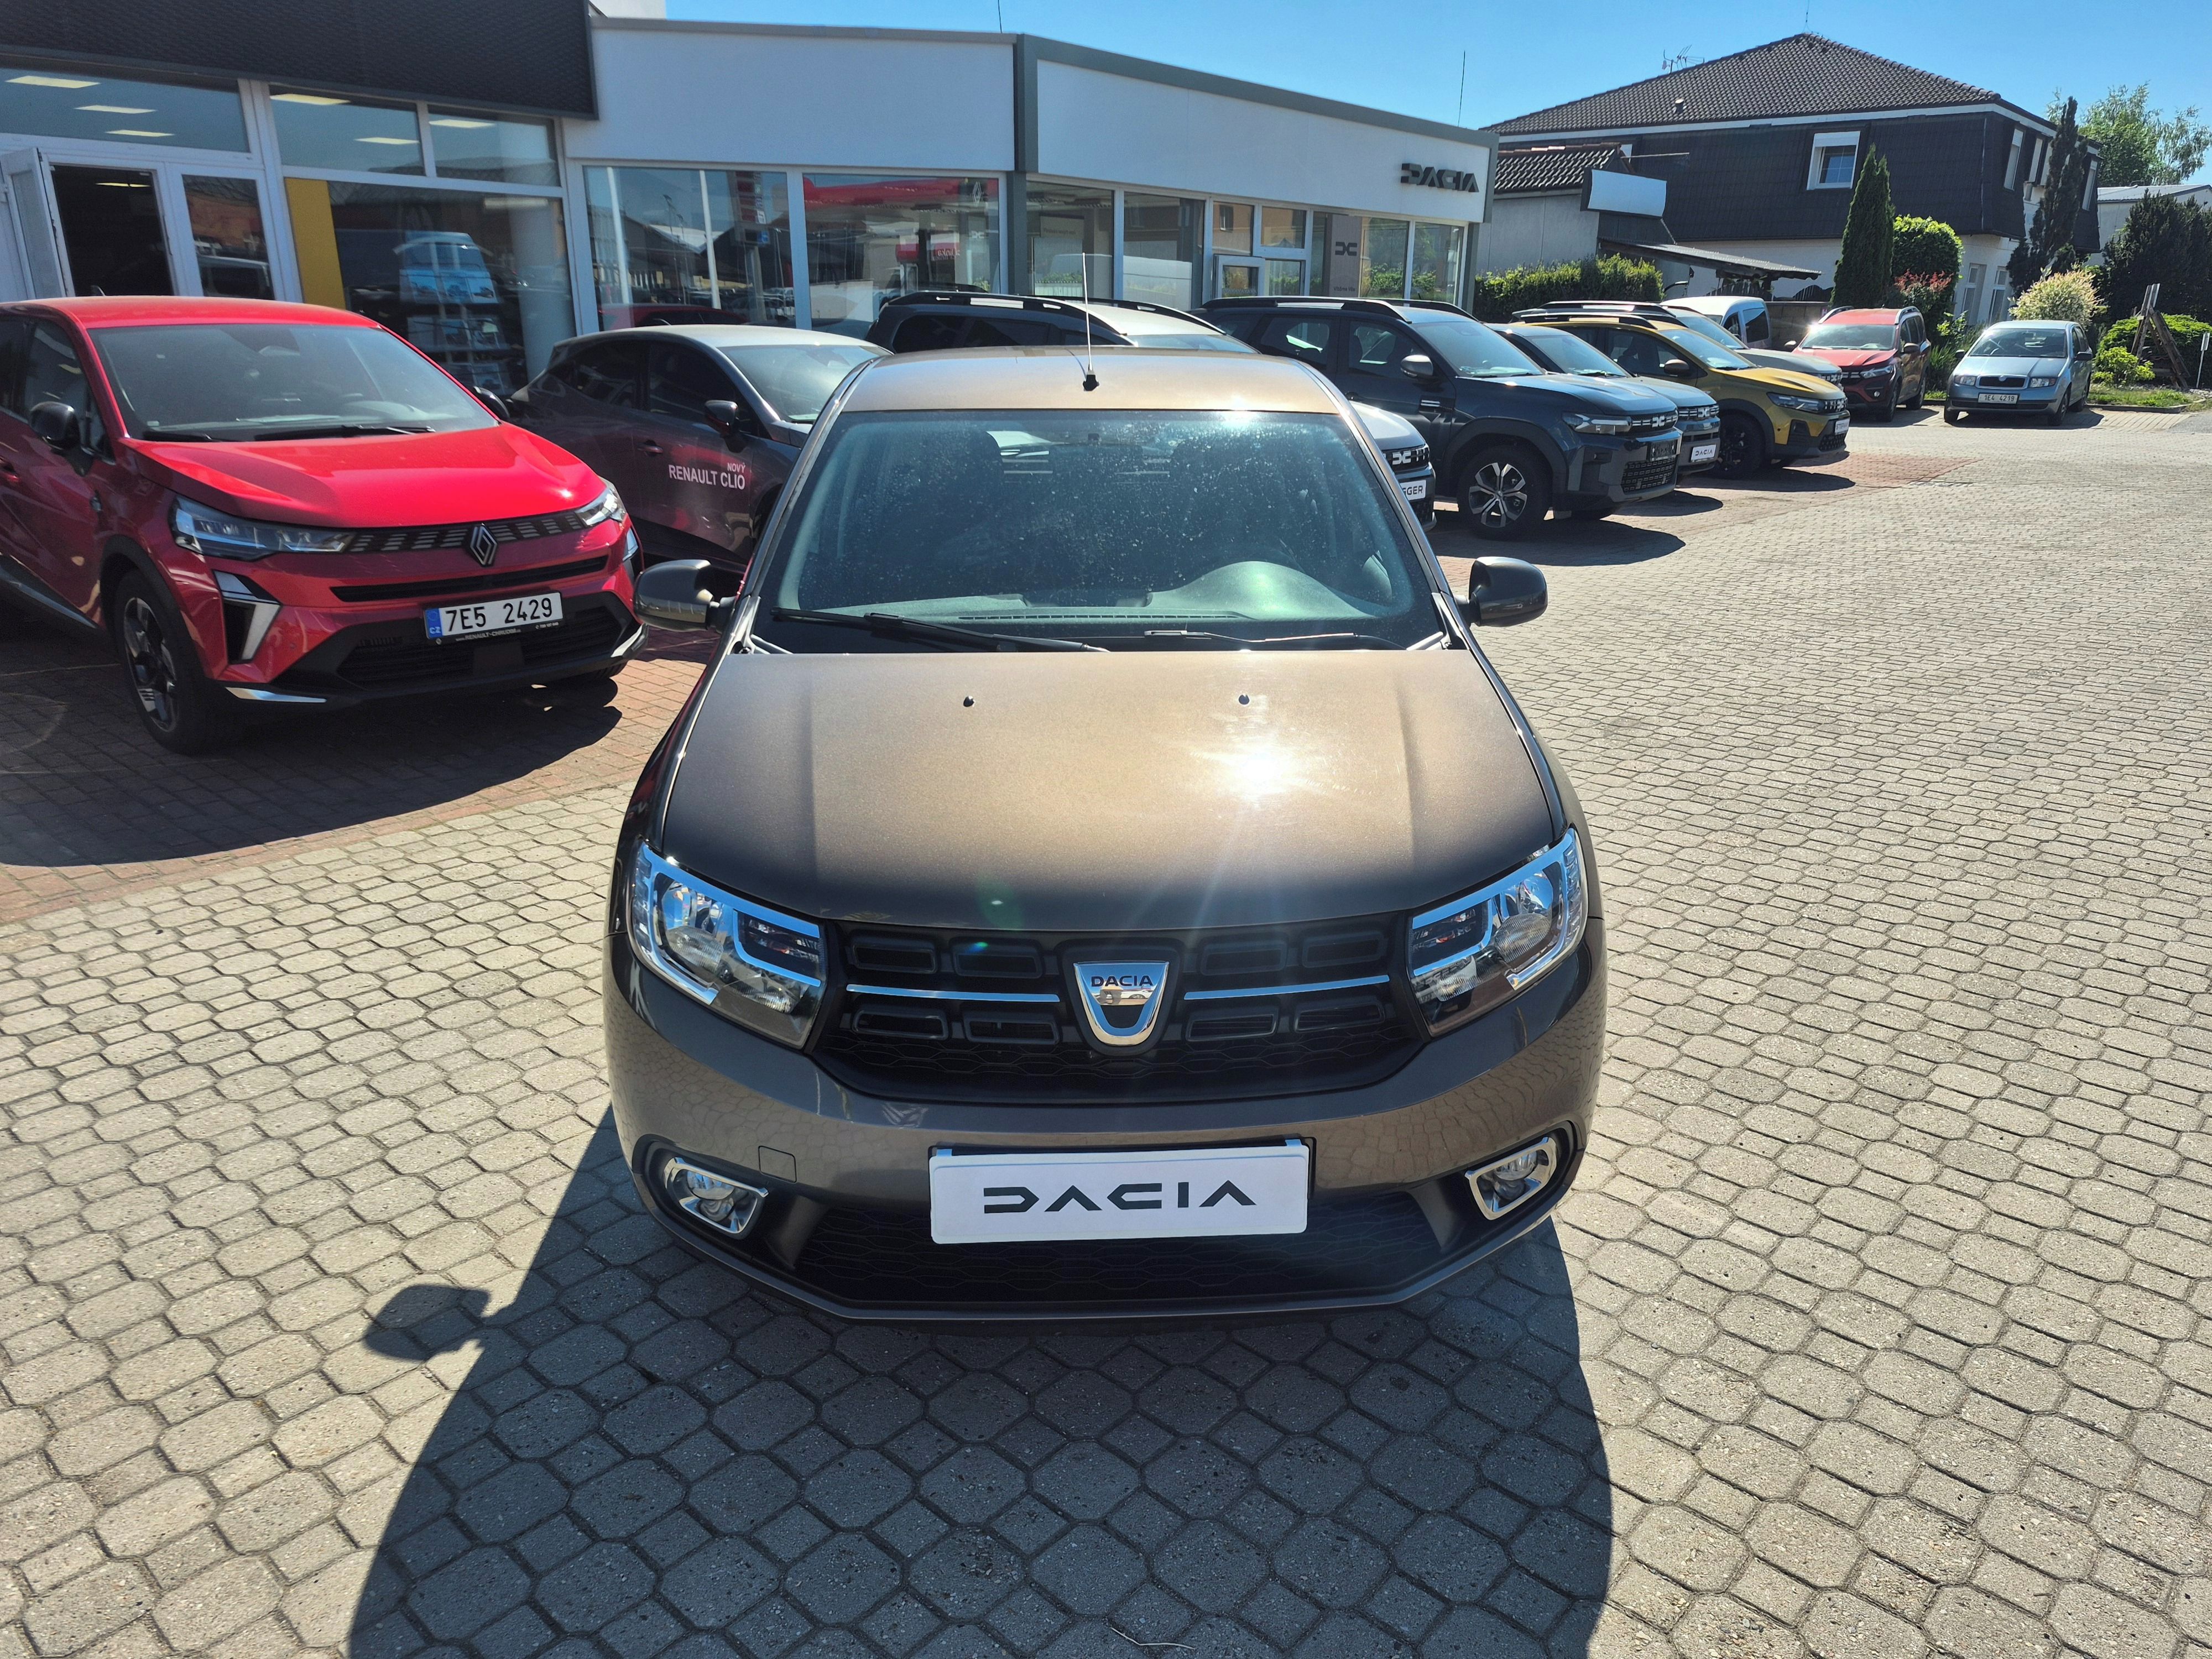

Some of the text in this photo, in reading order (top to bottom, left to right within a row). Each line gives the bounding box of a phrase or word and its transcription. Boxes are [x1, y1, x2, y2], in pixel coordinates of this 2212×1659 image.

[1401, 163, 1479, 192] DACIA
[668, 465, 745, 490] RENAULT CLIO
[727, 462, 746, 473] NOVÝ
[446, 598, 552, 632] 7E5 2429
[429, 626, 441, 634] CZ
[1091, 975, 1153, 987] DACIA
[983, 1180, 1257, 1214] DACIA
